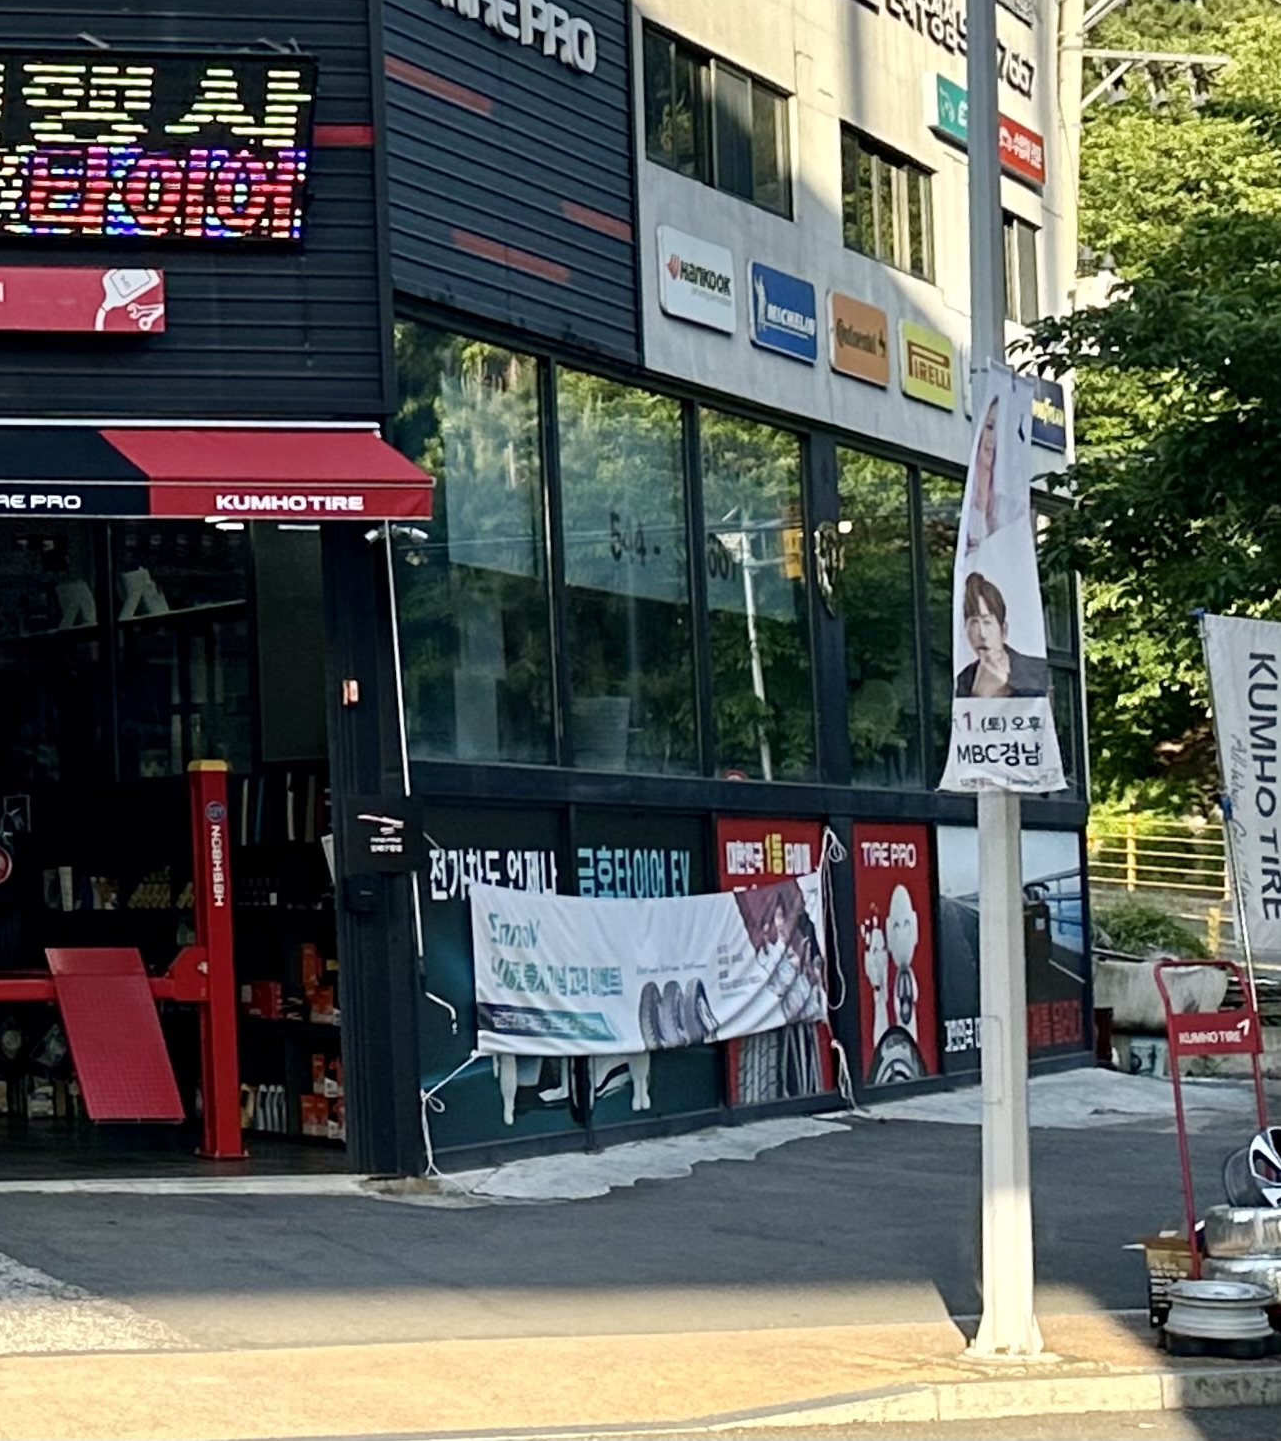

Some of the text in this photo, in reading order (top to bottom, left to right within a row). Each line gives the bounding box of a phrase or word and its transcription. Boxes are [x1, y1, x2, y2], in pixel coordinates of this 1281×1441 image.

[907, 340, 952, 391] PIRELLI
[30, 494, 82, 511] PRO
[956, 741, 1041, 767] MBC경남
[1248, 652, 1279, 818] KUMHO
[577, 845, 691, 898] 금호타이어 EV
